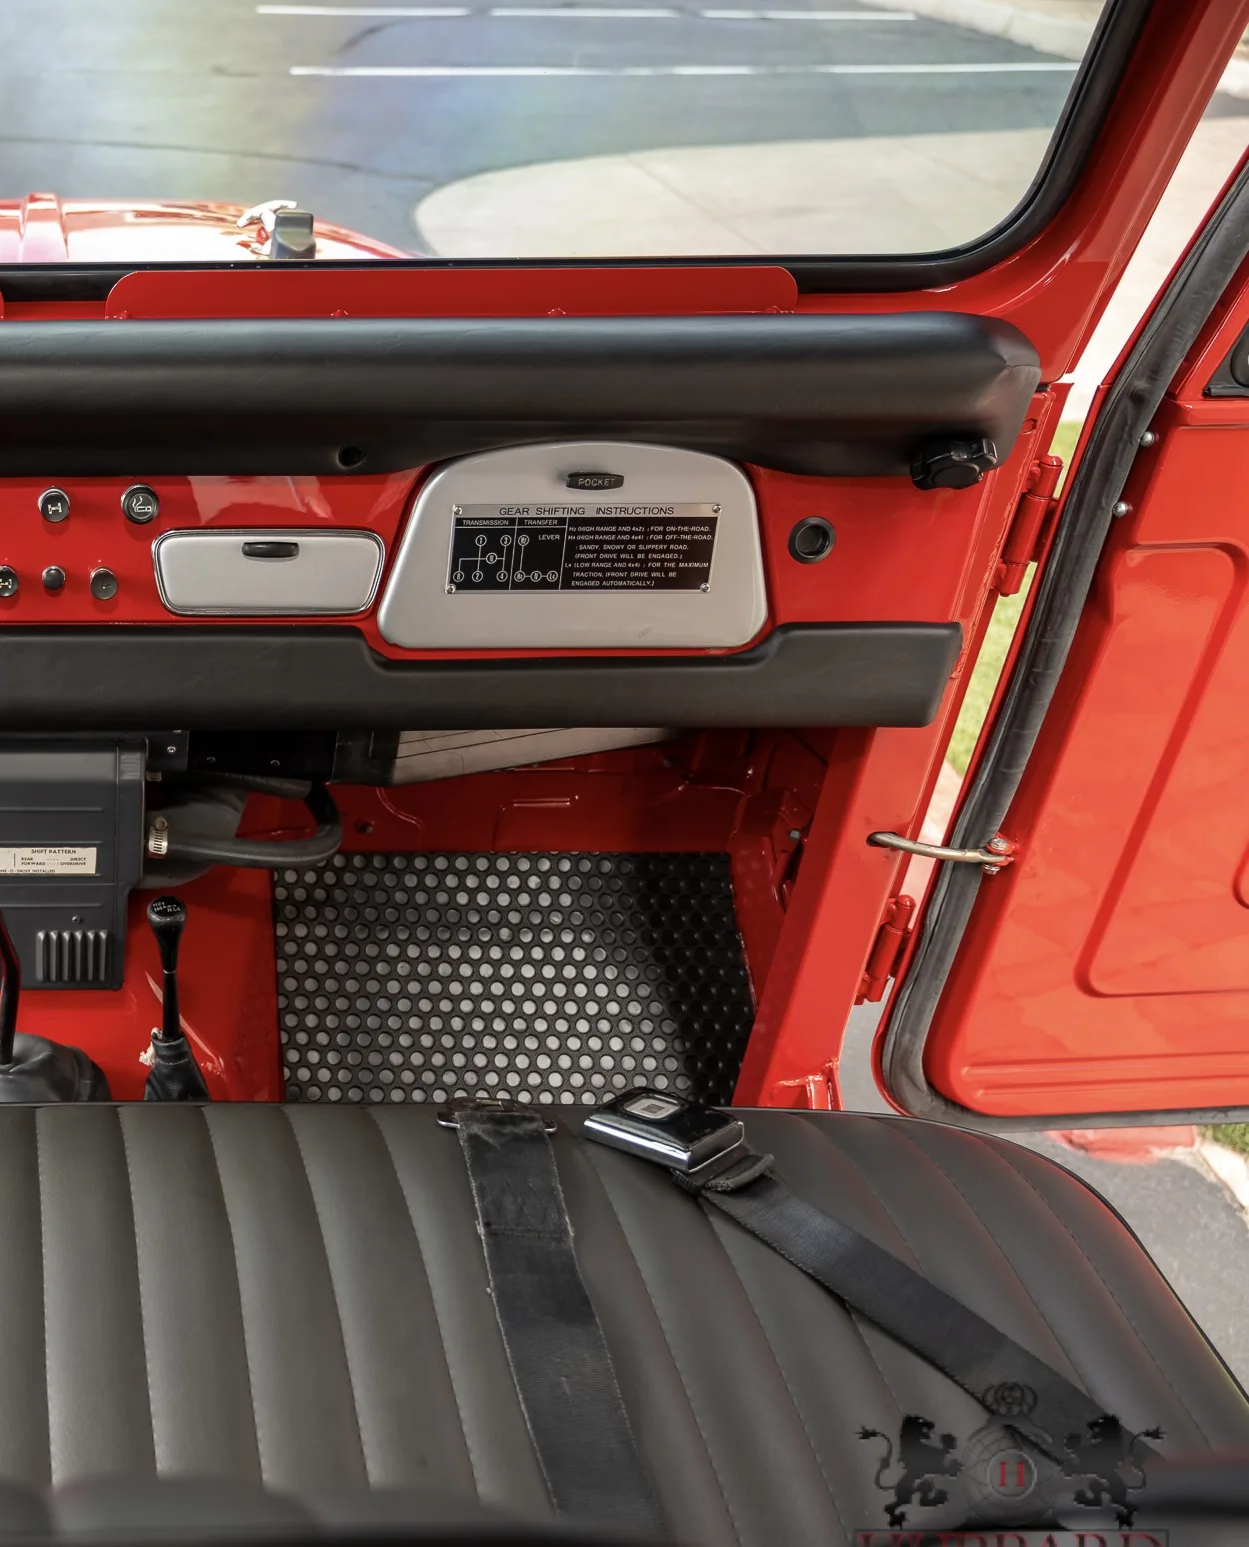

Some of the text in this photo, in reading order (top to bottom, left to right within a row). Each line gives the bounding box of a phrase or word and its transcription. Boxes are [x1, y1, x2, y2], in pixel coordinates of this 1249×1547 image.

[578, 478, 615, 487] POCKET
[499, 506, 675, 516] GEAR SHIFTING INSTRUCTIONS
